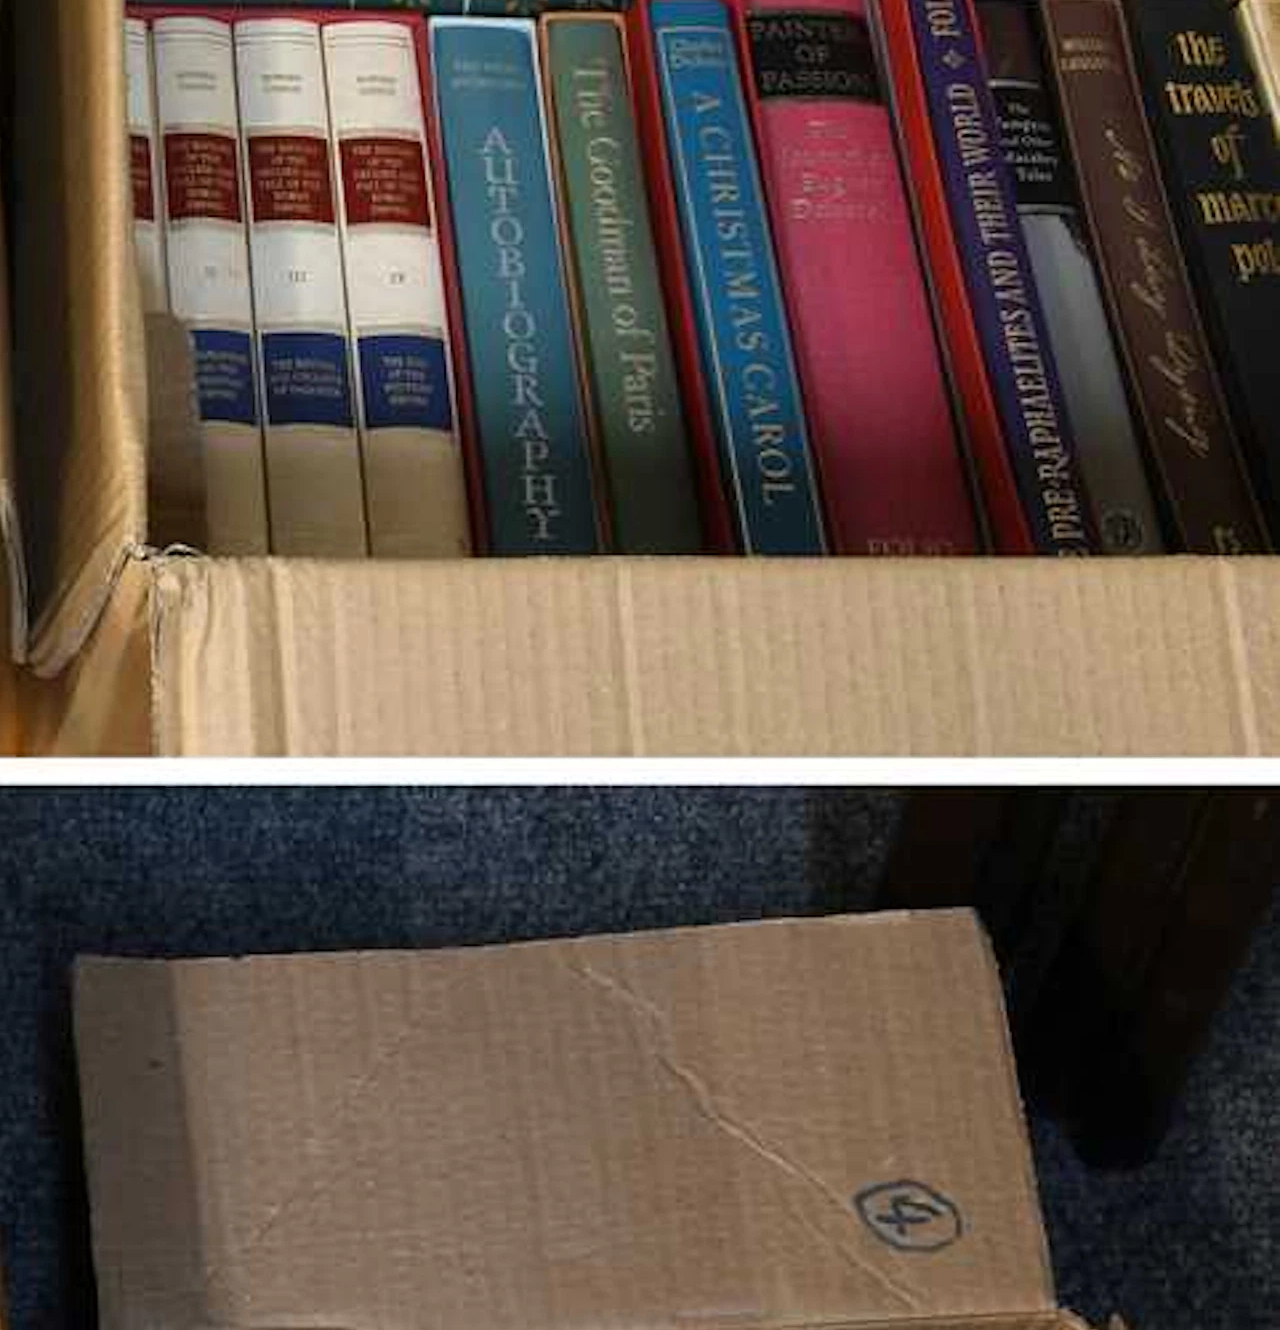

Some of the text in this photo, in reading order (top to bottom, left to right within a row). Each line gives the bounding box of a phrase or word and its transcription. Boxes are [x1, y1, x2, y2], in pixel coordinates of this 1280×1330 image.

[794, 44, 829, 64] OF
[1171, 30, 1230, 68] the
[948, 83, 993, 168] WORLD
[1210, 121, 1248, 180] of
[967, 171, 1013, 242] THEIR
[570, 60, 615, 128] The
[614, 345, 659, 433] Paris
[986, 250, 1023, 301] AND
[481, 125, 559, 541] AUTOBIOGRAPHY
[687, 90, 796, 507] A CHRISTMAS CAROL
